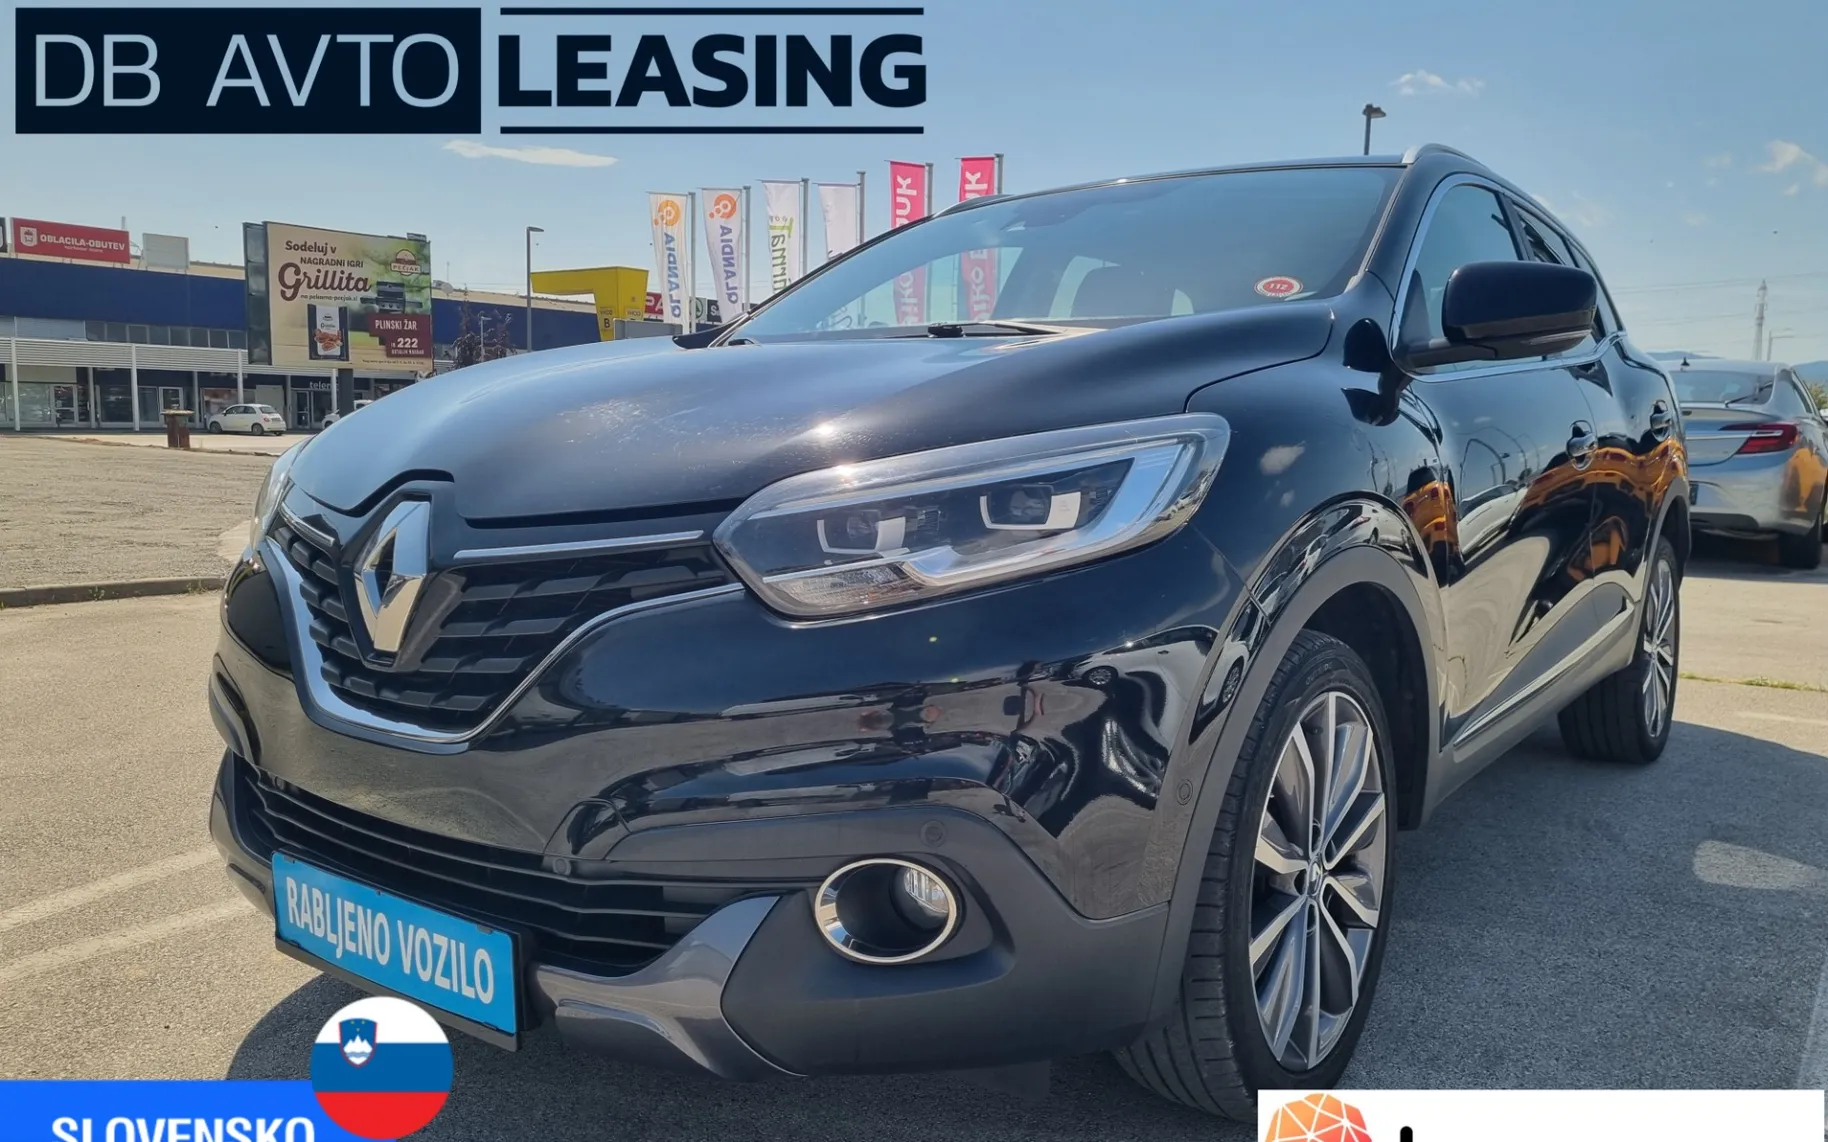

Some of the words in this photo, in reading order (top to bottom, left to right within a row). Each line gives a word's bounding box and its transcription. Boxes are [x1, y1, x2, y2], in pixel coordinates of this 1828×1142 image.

[285, 240, 328, 256] Sodeluj
[330, 246, 337, 254] v
[300, 256, 345, 267] NAGRADNI
[347, 260, 363, 268] IGRI
[278, 262, 372, 301] Grillita
[375, 319, 402, 330] PLINSKI
[403, 319, 417, 330] ŽAR
[397, 337, 419, 348] 222
[286, 877, 391, 966] RABLJENO
[397, 919, 495, 1005] VOZILO
